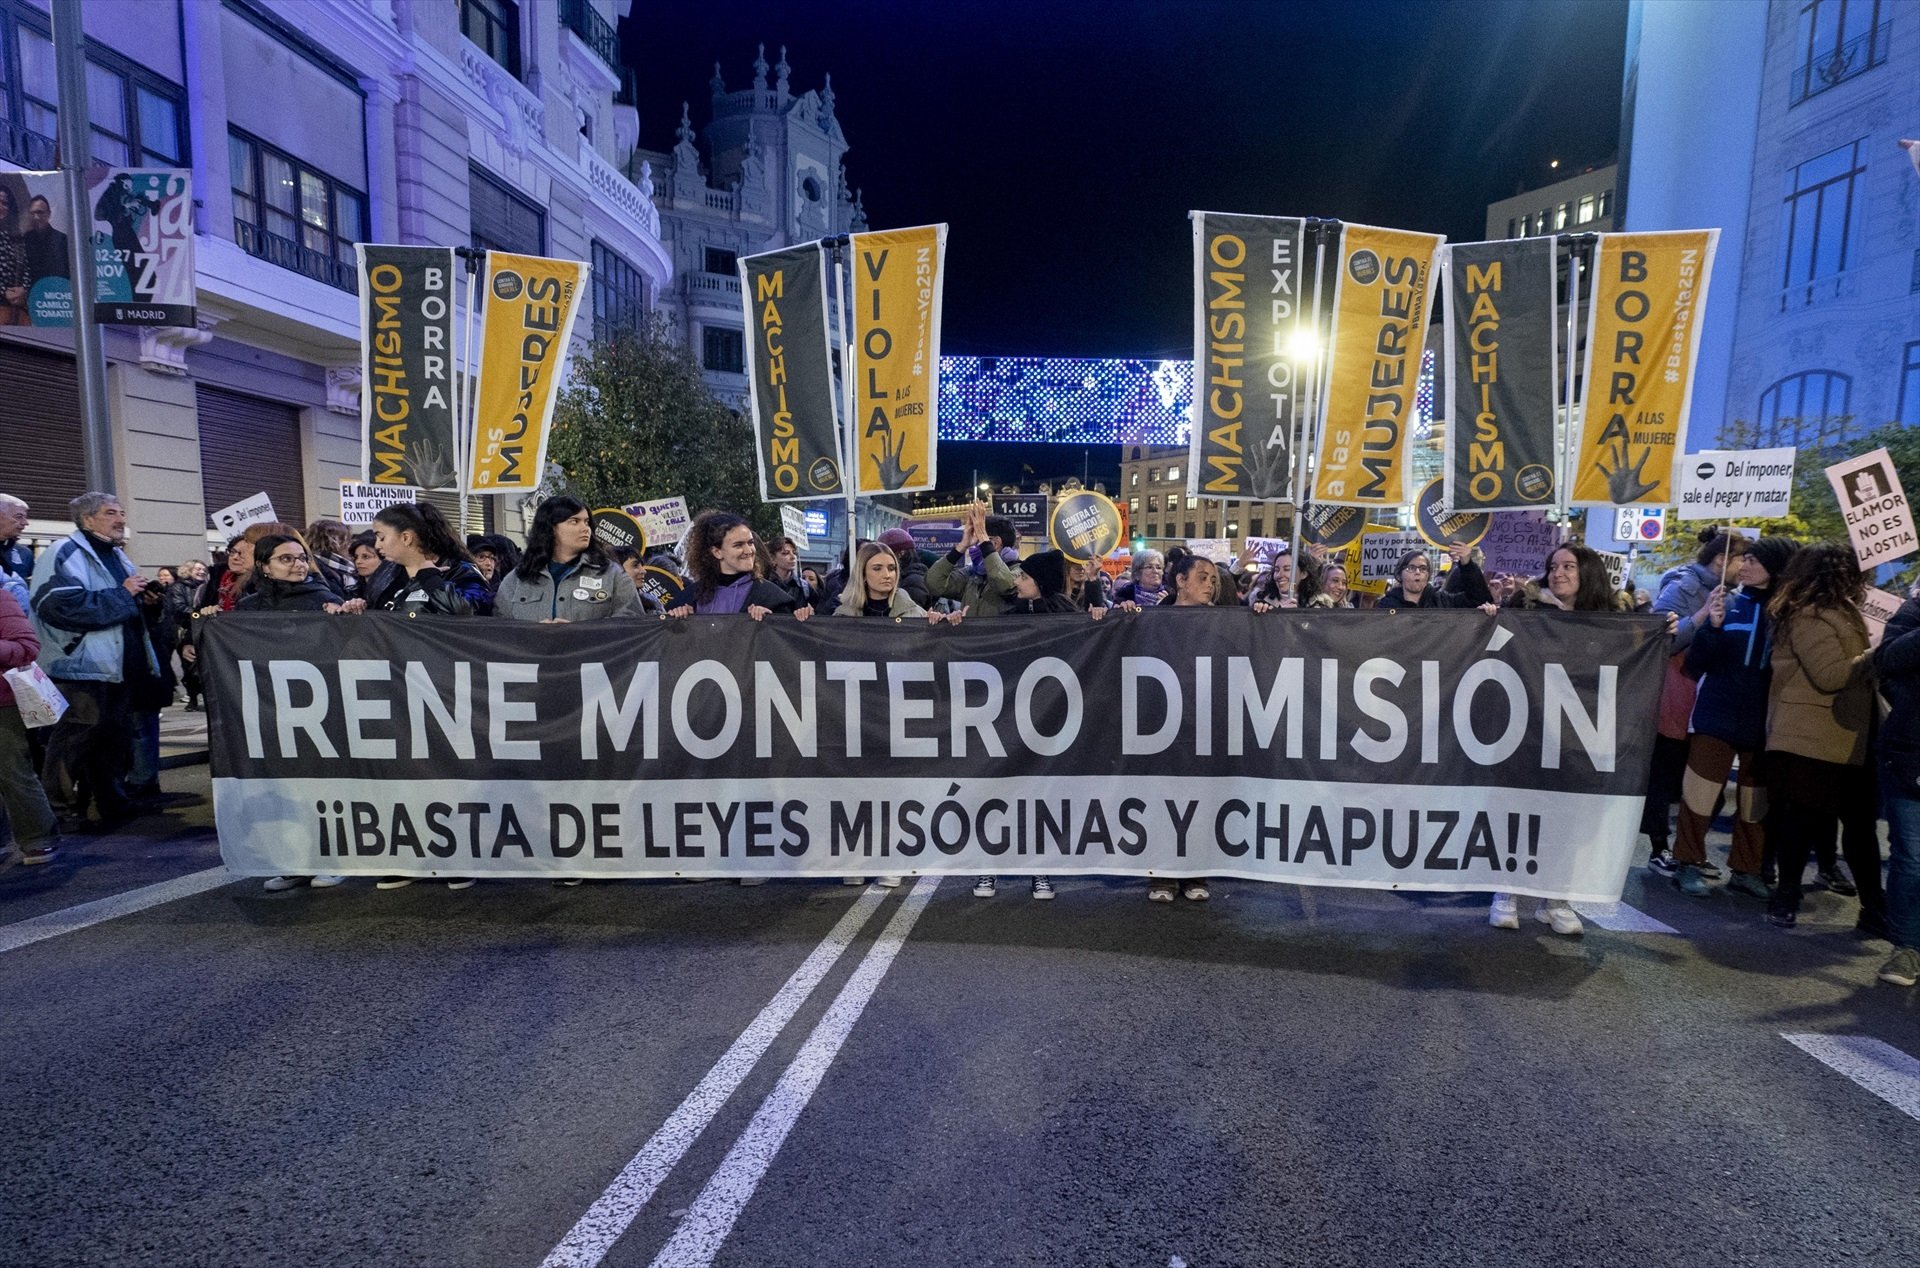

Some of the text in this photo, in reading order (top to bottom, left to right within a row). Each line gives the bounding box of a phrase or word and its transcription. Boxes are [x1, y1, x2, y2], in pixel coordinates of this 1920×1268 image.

[96, 264, 124, 277] NOV
[36, 301, 70, 309] CAMILO
[44, 292, 73, 300] MICHE
[36, 310, 74, 318] TOMATIT
[127, 308, 166, 321] MADRID
[1664, 248, 1698, 384] #BastaYa25N
[421, 267, 447, 409] BORRA
[864, 249, 892, 438] VIOLA
[1266, 239, 1291, 450] EXPLOTA
[1597, 251, 1650, 445] BORRA
[370, 264, 410, 484] MACHISMO
[1205, 234, 1246, 493] MACHISMO
[757, 270, 799, 493] MACHISMO
[1357, 255, 1419, 499] MUJERES
[1466, 261, 1504, 502] MACHISMO
[1636, 411, 1664, 425] A LAS
[1633, 430, 1676, 446] MUJERES
[1327, 429, 1350, 498] a las
[1725, 461, 1792, 481] Del imponer,
[342, 485, 413, 499] EL MACHISMO
[1683, 487, 1788, 508] sale el pegar y matar.
[343, 501, 353, 509] es
[344, 511, 375, 522] CONTR
[1001, 502, 1037, 514] 1.168
[1062, 504, 1100, 529] CONTRA EL
[1846, 494, 1905, 526] EL AMOR
[599, 518, 627, 540] CONTRA
[625, 535, 636, 545] EL
[1065, 517, 1098, 538] BORRADO
[1318, 506, 1357, 540] MUJERES
[1492, 520, 1510, 533] NO
[1859, 514, 1902, 541] NO ES
[1071, 523, 1110, 550] MUJERES
[1364, 538, 1377, 546] Por
[1391, 537, 1404, 546] por
[1858, 531, 1915, 562] LA OSTIA.
[1364, 548, 1379, 560] NO
[1496, 556, 1545, 570] PATRIARCA
[1363, 563, 1397, 577] EL MAL
[648, 577, 660, 587] EL
[238, 625, 1619, 773] IRENE MONTERO DIMISIÓN
[549, 802, 623, 859] DE
[643, 799, 810, 859] LEYES
[830, 782, 1149, 858] MISÓGINAS
[1164, 799, 1199, 858] Y
[1214, 798, 1541, 875] CHAPUZA!!
